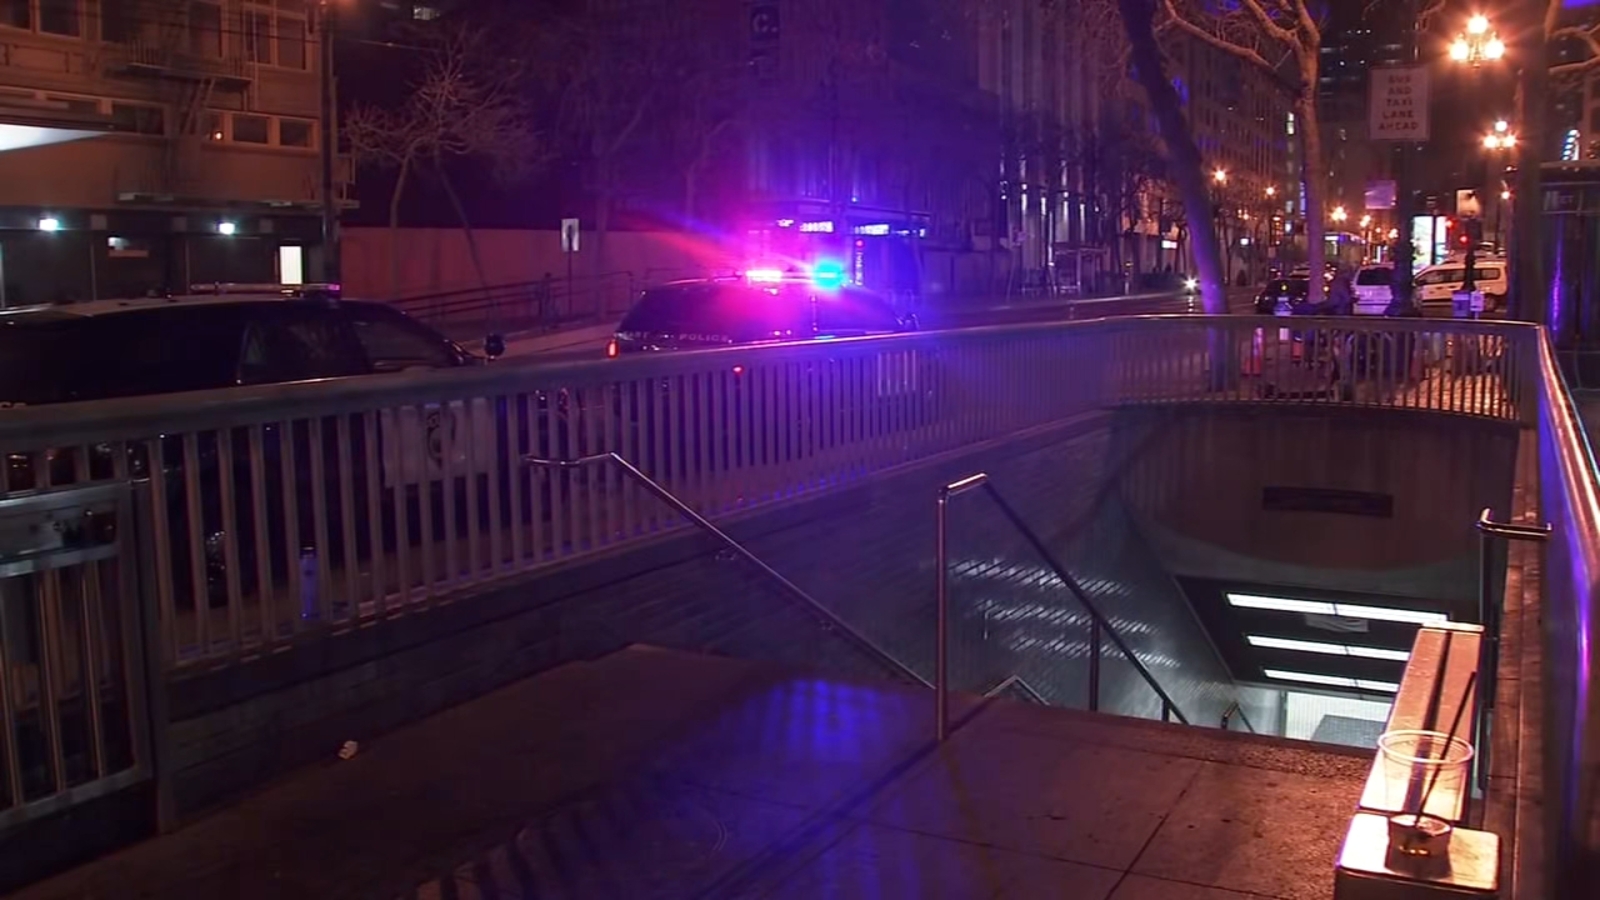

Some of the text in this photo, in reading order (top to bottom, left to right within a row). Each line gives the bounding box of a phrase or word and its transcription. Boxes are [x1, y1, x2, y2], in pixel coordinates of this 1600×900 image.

[1388, 86, 1412, 95] AND
[1386, 98, 1413, 107] TAXI
[1382, 110, 1413, 119] LANE
[1378, 122, 1418, 130] AHEAD
[679, 333, 729, 342] POLICE
